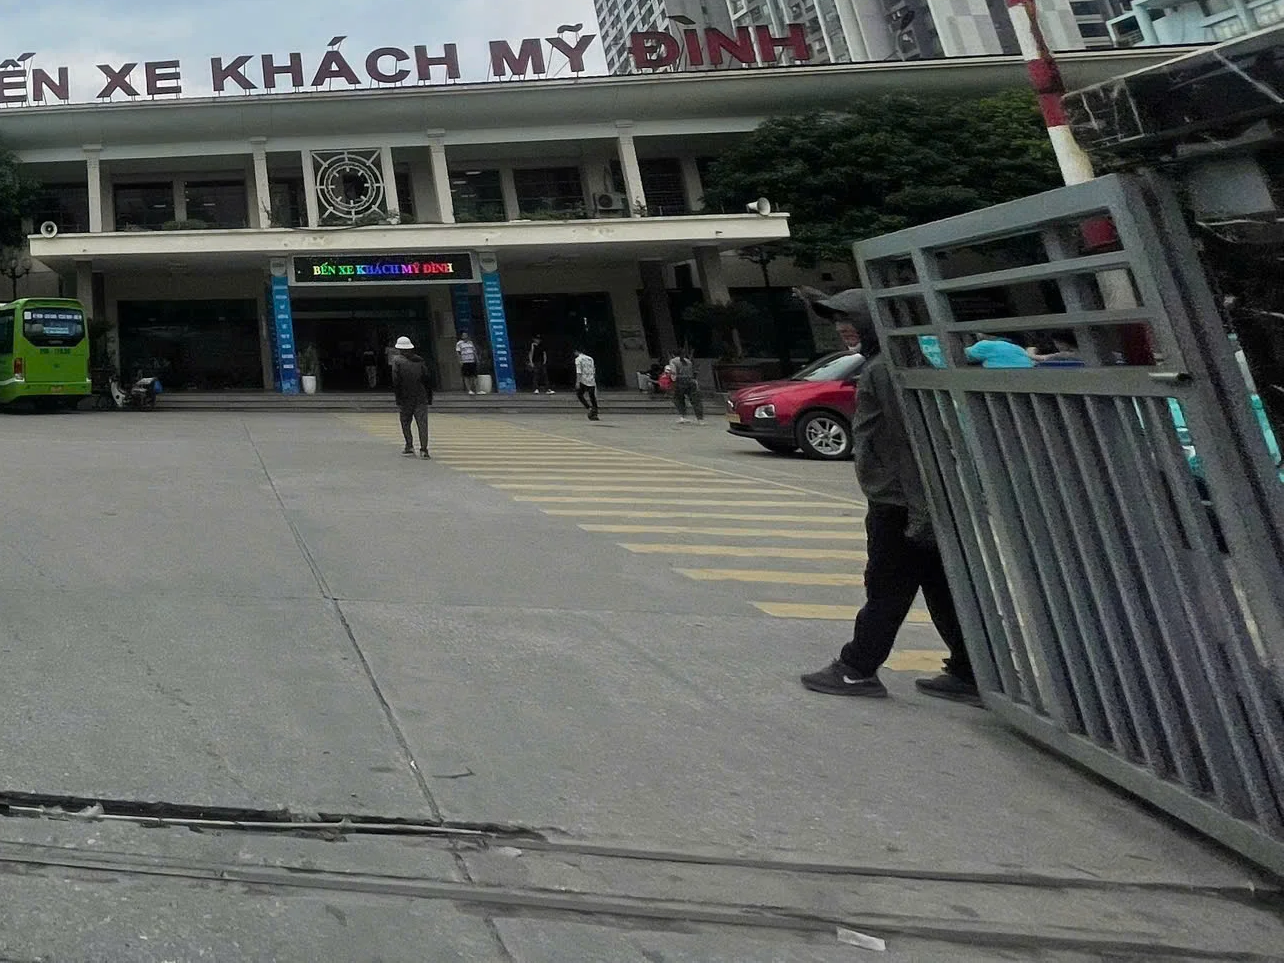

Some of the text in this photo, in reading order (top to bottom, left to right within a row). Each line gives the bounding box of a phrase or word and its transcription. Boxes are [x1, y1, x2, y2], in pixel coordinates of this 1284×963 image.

[96, 60, 182, 98] XE
[211, 35, 461, 91] KHÁCH
[489, 23, 596, 77] MỸ
[628, 15, 812, 69] ĐÌNH
[313, 261, 454, 275] BẾN XE KHÁCH MỸ ĐÌNH
